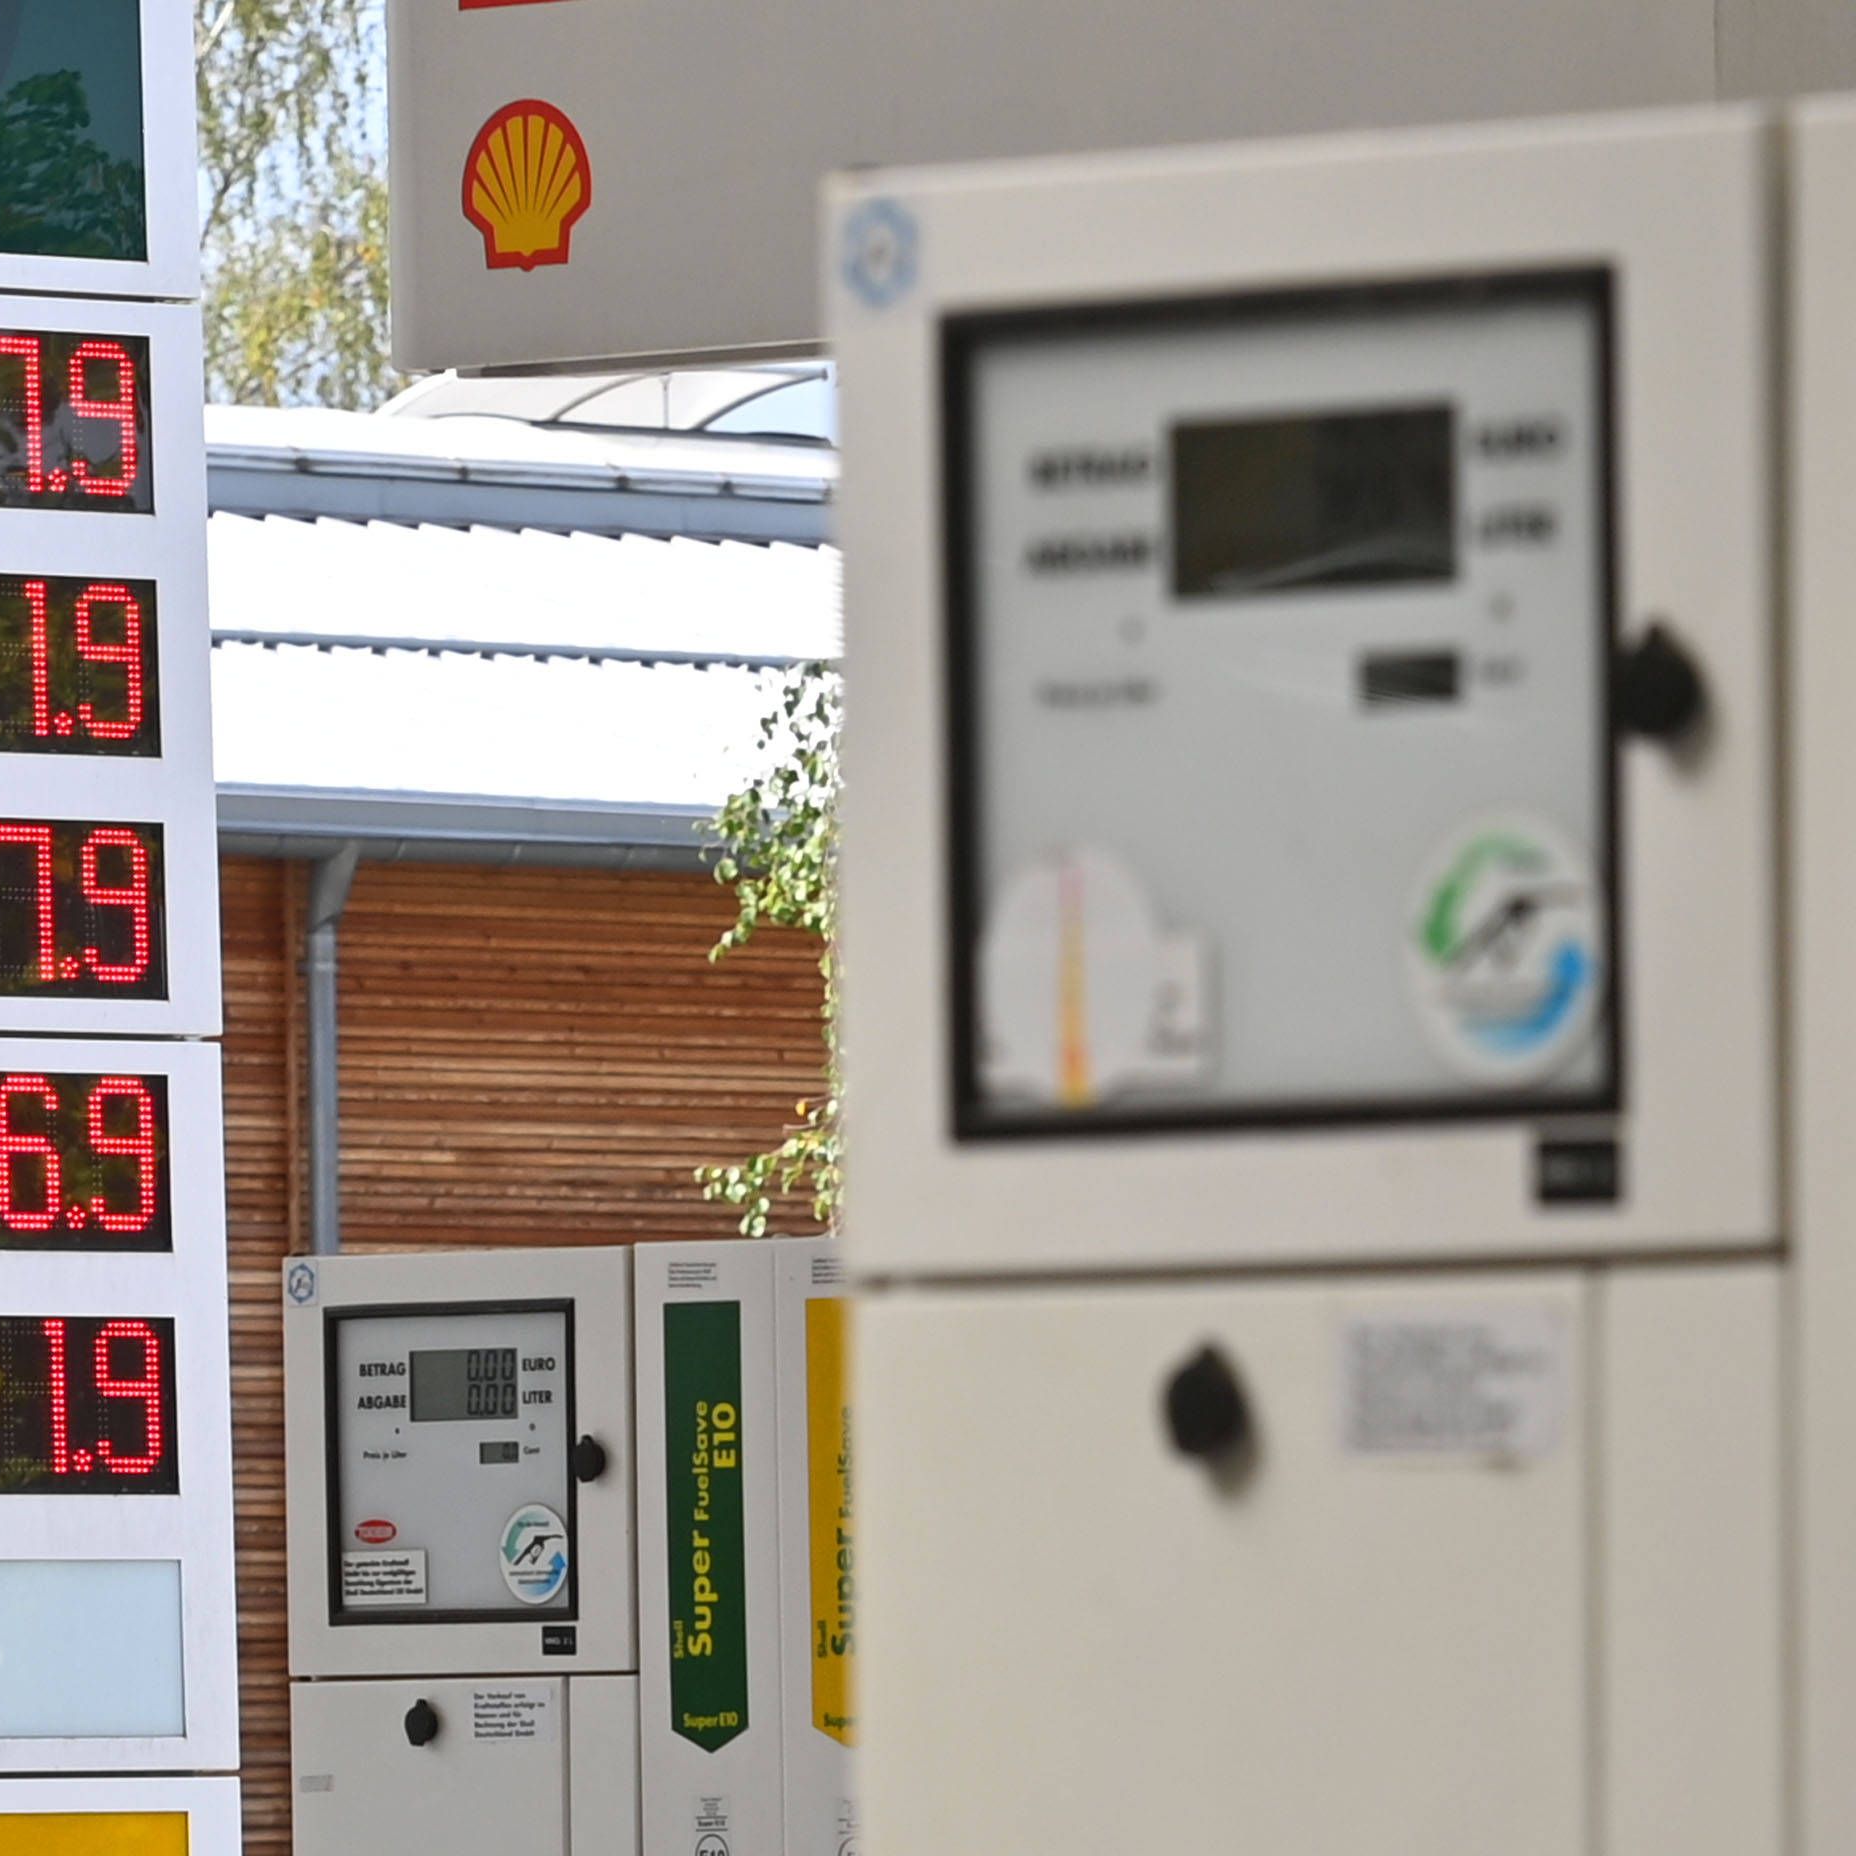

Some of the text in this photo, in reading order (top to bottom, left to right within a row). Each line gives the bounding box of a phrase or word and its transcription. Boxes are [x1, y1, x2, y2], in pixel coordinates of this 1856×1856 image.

[359, 1362, 406, 1377] BETRAG
[522, 1357, 555, 1371] EURO
[357, 1395, 406, 1410] ABGABE
[522, 1391, 552, 1404] LITER
[712, 1402, 736, 1468] E10
[688, 1401, 719, 1657] Super FuelSave
[683, 1711, 739, 1731] Super E10
